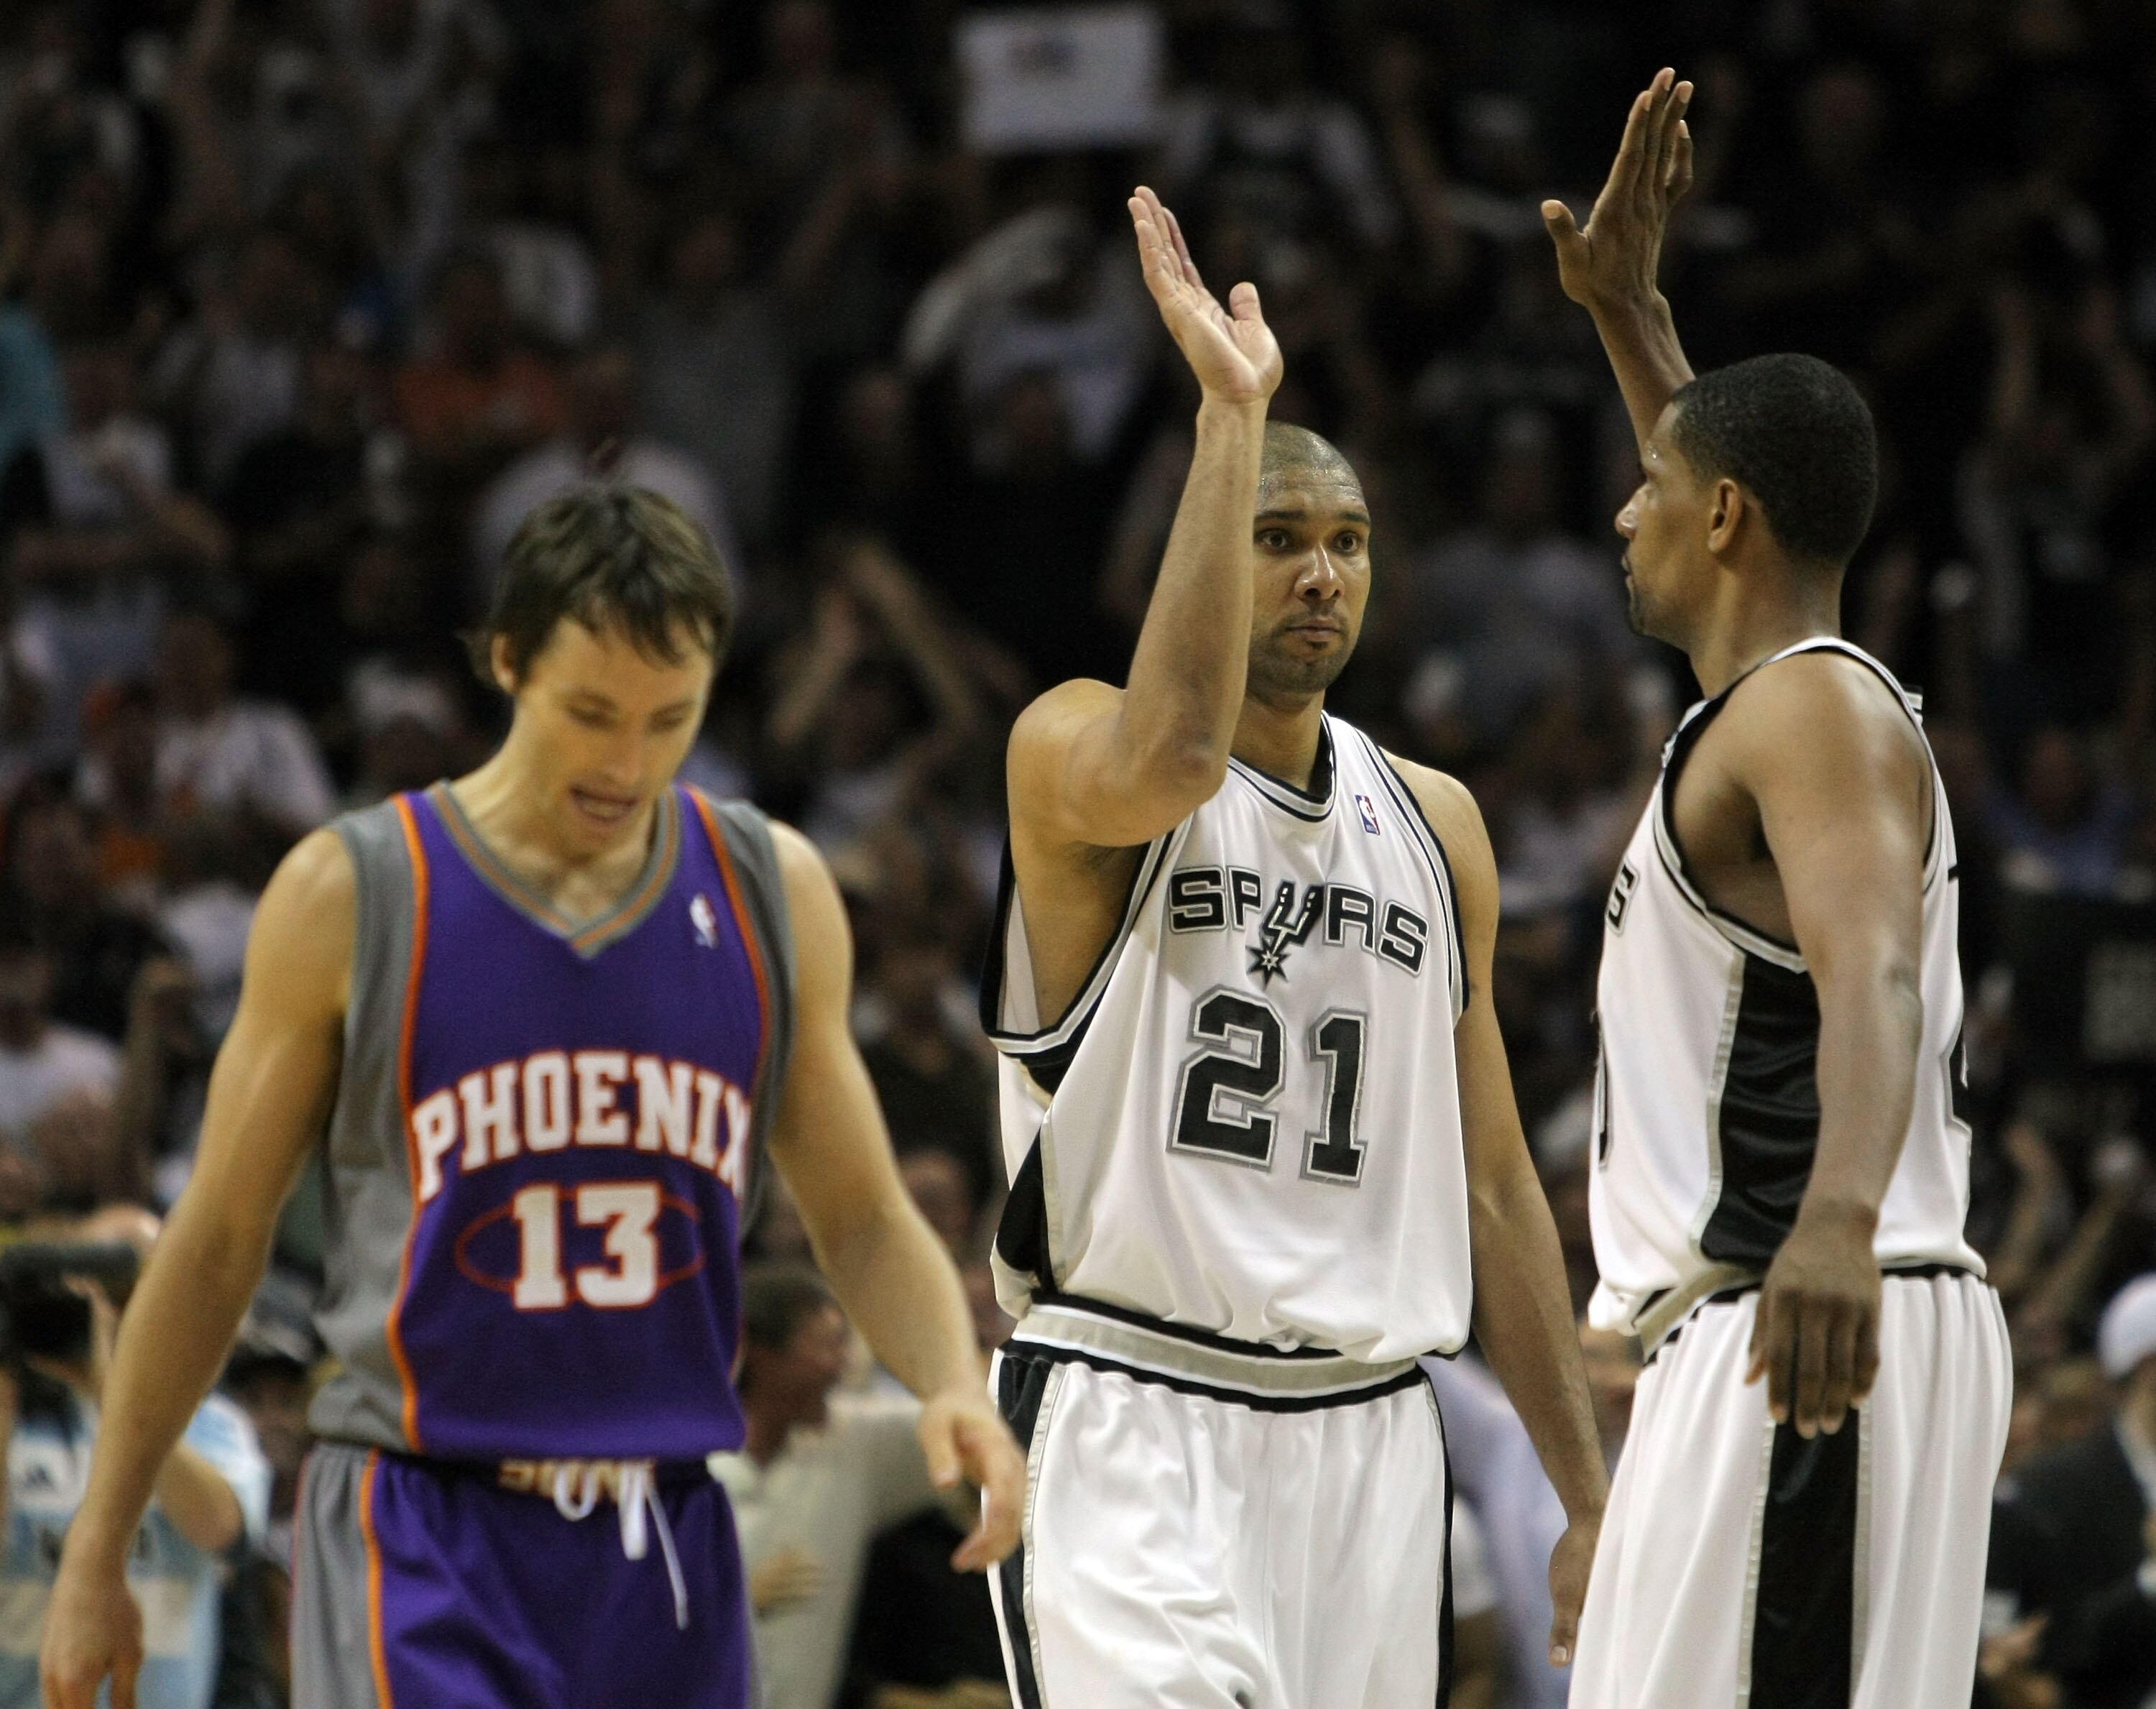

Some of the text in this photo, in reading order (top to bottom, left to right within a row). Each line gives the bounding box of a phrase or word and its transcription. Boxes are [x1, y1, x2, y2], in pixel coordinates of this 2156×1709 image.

[1169, 865, 1429, 977] SPURS
[411, 1049, 753, 1204] PHOENIX
[1166, 984, 1368, 1188] 21
[512, 1182, 662, 1310] 13
